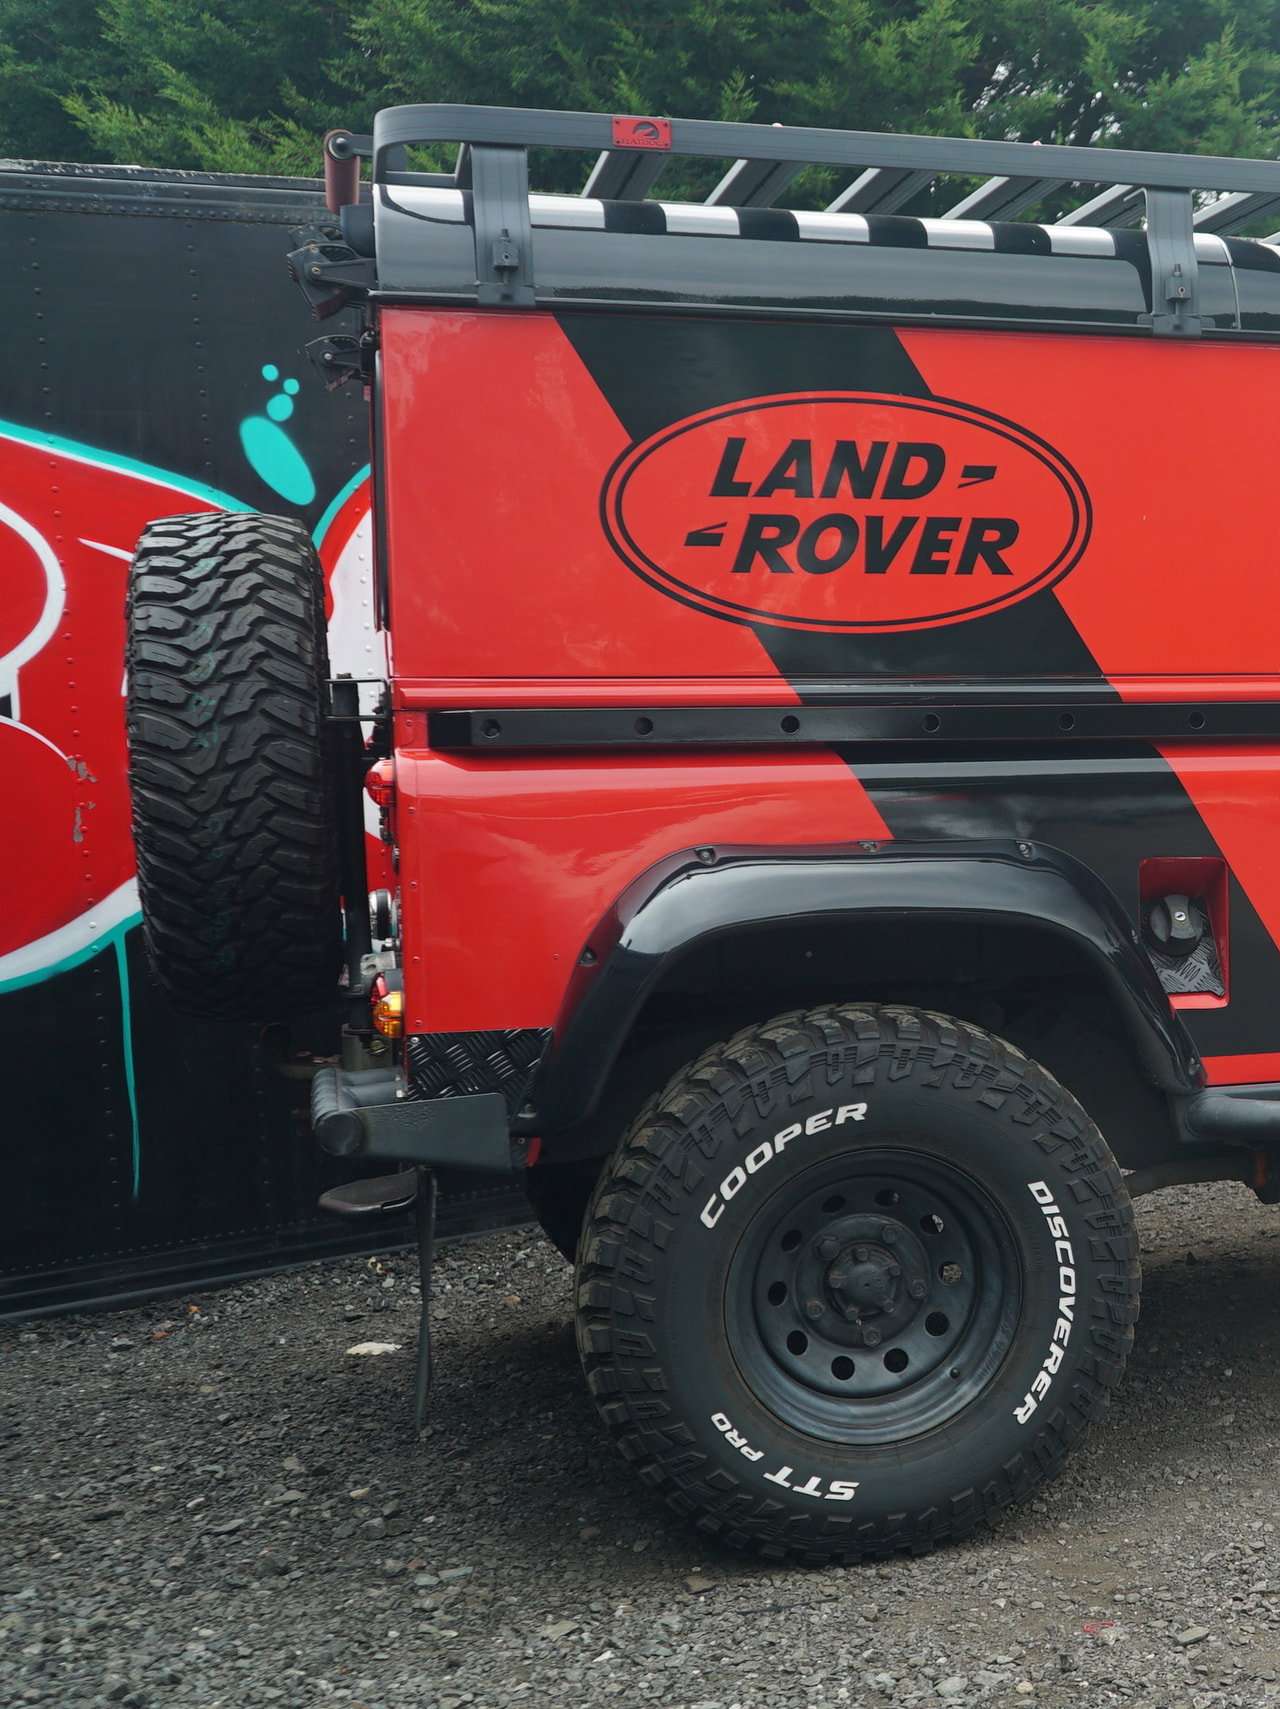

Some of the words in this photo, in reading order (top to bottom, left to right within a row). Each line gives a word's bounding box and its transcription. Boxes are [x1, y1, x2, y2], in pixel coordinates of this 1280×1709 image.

[709, 437, 946, 500] LAND
[731, 513, 1019, 575] ROVER
[700, 1102, 868, 1229] COOPER
[1012, 1180, 1077, 1425] DISCOVERER
[710, 1412, 765, 1461] PRO
[763, 1466, 860, 1501] STT
